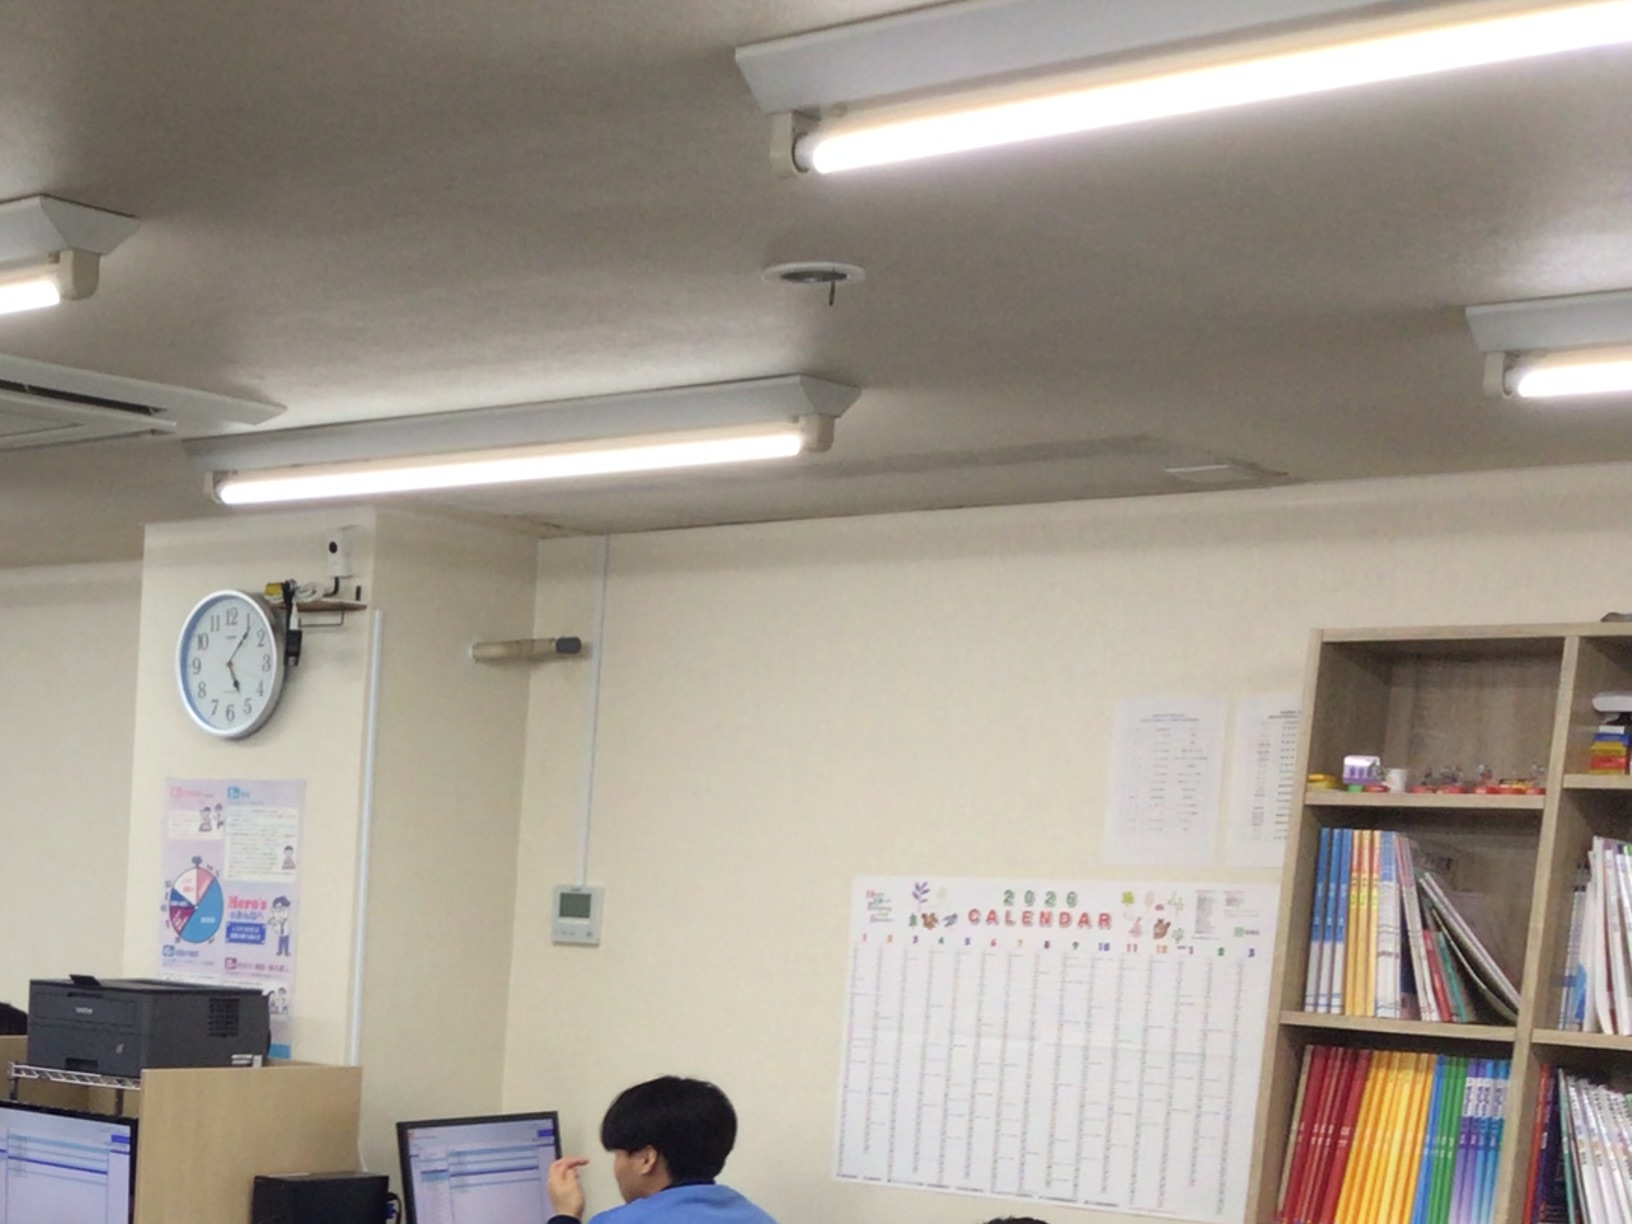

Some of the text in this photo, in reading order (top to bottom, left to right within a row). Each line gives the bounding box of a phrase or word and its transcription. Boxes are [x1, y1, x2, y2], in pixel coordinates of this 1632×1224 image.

[210, 614, 220, 632] 11
[226, 607, 238, 626] 12
[197, 633, 209, 651] 10
[257, 629, 265, 648] 2
[192, 657, 201, 675] 9
[262, 654, 271, 672] 3
[198, 681, 207, 699] 8
[256, 680, 264, 697] 4
[211, 699, 219, 716] 7
[226, 704, 235, 721] 6
[243, 697, 252, 715] 5
[228, 895, 267, 911] Hero's
[968, 908, 1112, 930] CALENDAR
